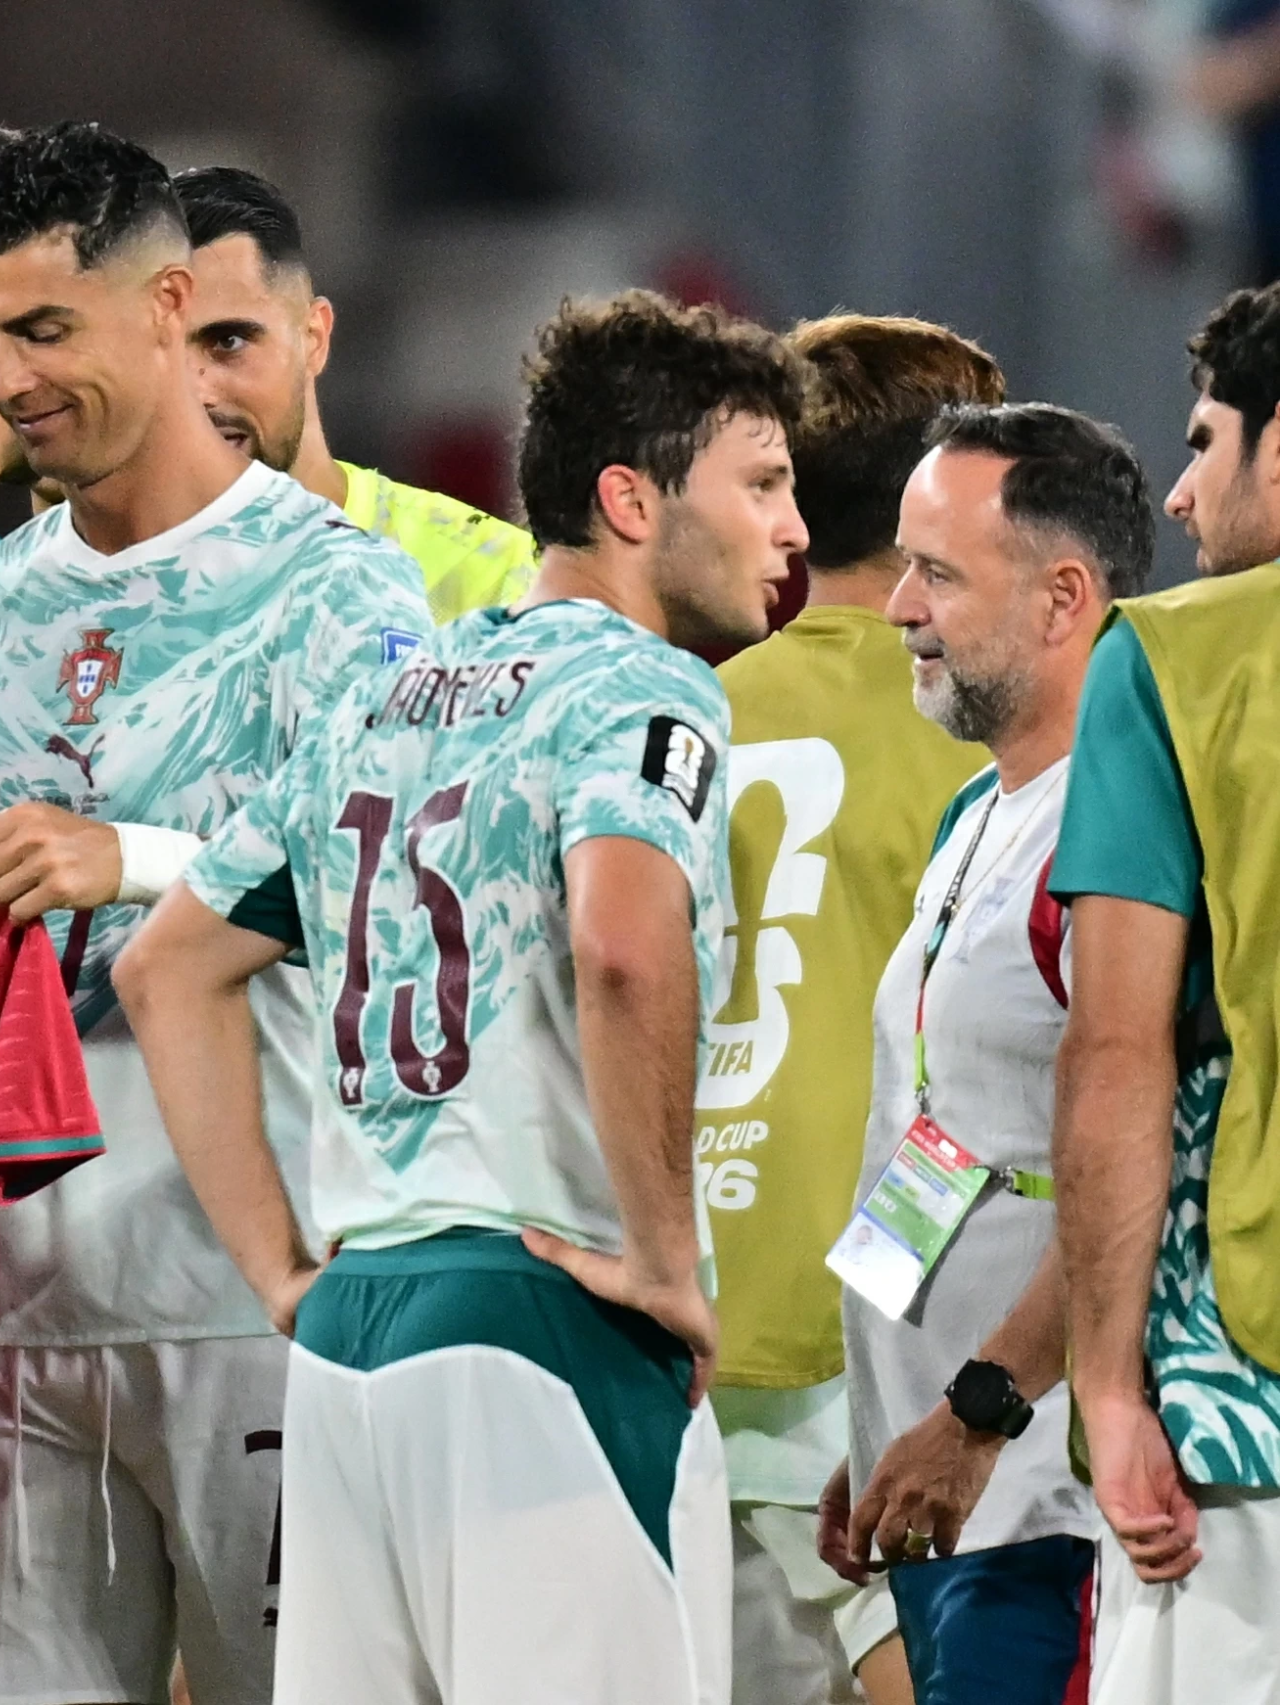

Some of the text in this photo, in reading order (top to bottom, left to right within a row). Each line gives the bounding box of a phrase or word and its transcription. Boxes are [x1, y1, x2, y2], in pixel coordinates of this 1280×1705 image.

[332, 780, 471, 1106] 15
[708, 1040, 753, 1076] IFA
[715, 1120, 769, 1152] CUP
